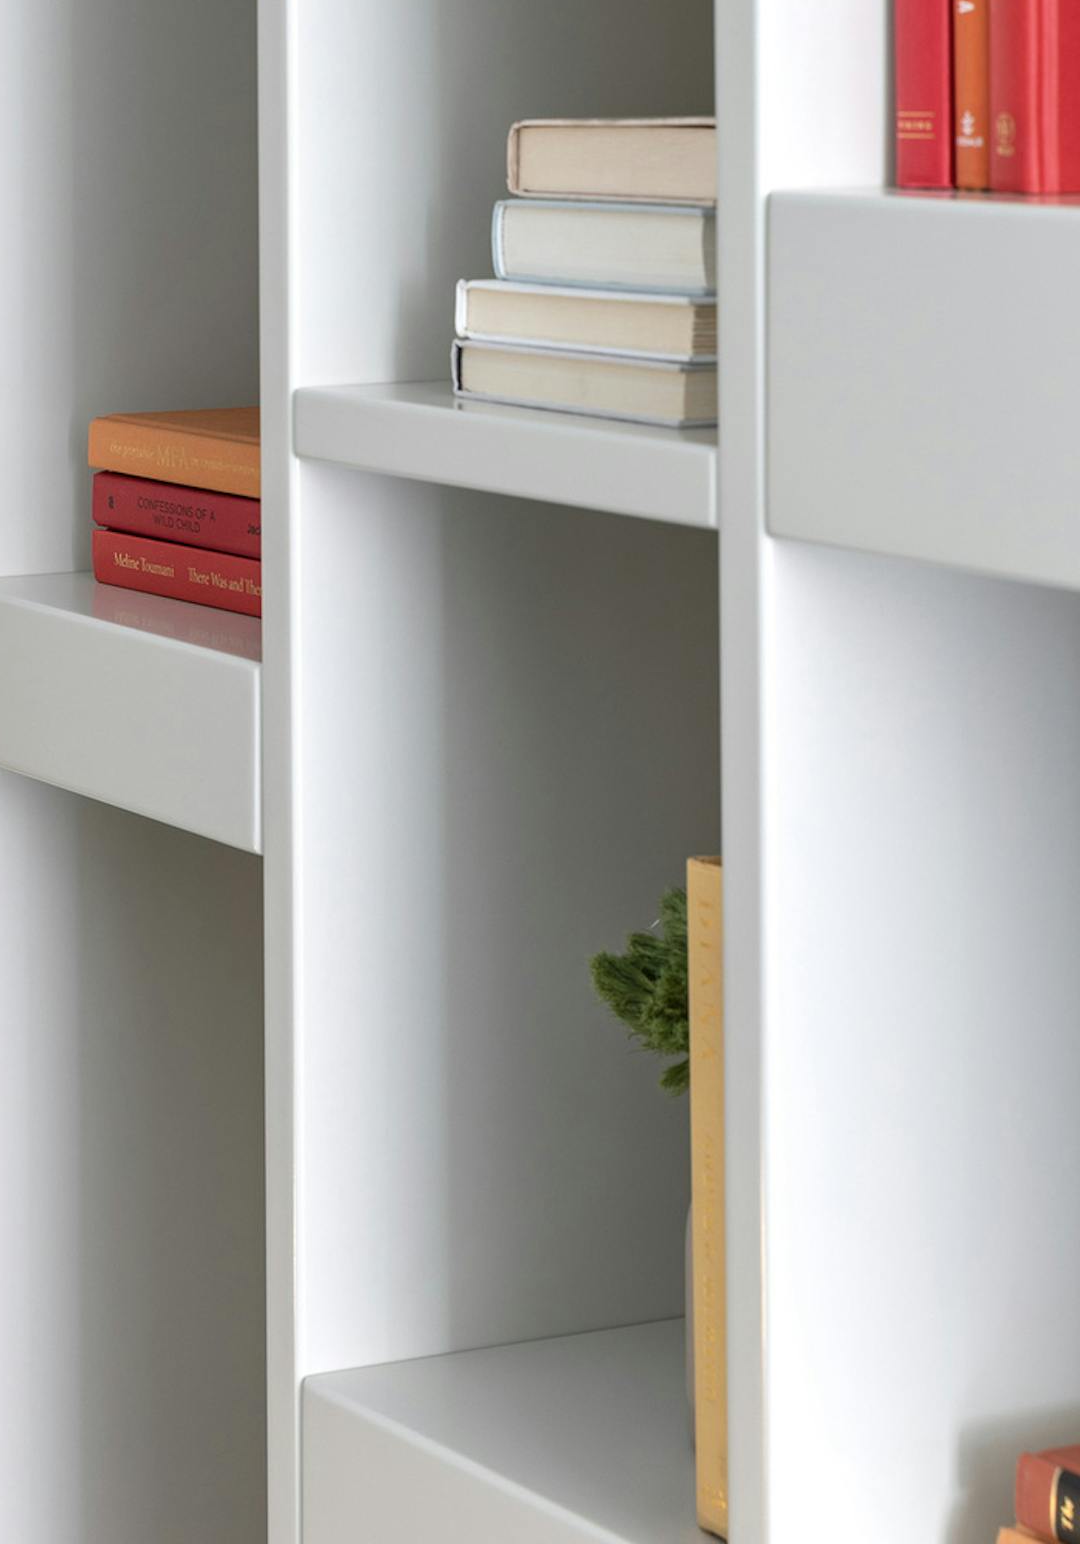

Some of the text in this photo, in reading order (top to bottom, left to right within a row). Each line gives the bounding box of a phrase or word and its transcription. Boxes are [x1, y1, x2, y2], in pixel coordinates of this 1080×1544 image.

[137, 497, 217, 521] CONFESSIONS OF A
[153, 515, 201, 534] WILD CHILD
[188, 566, 210, 585] There
[210, 571, 228, 589] Was
[228, 576, 244, 592] and
